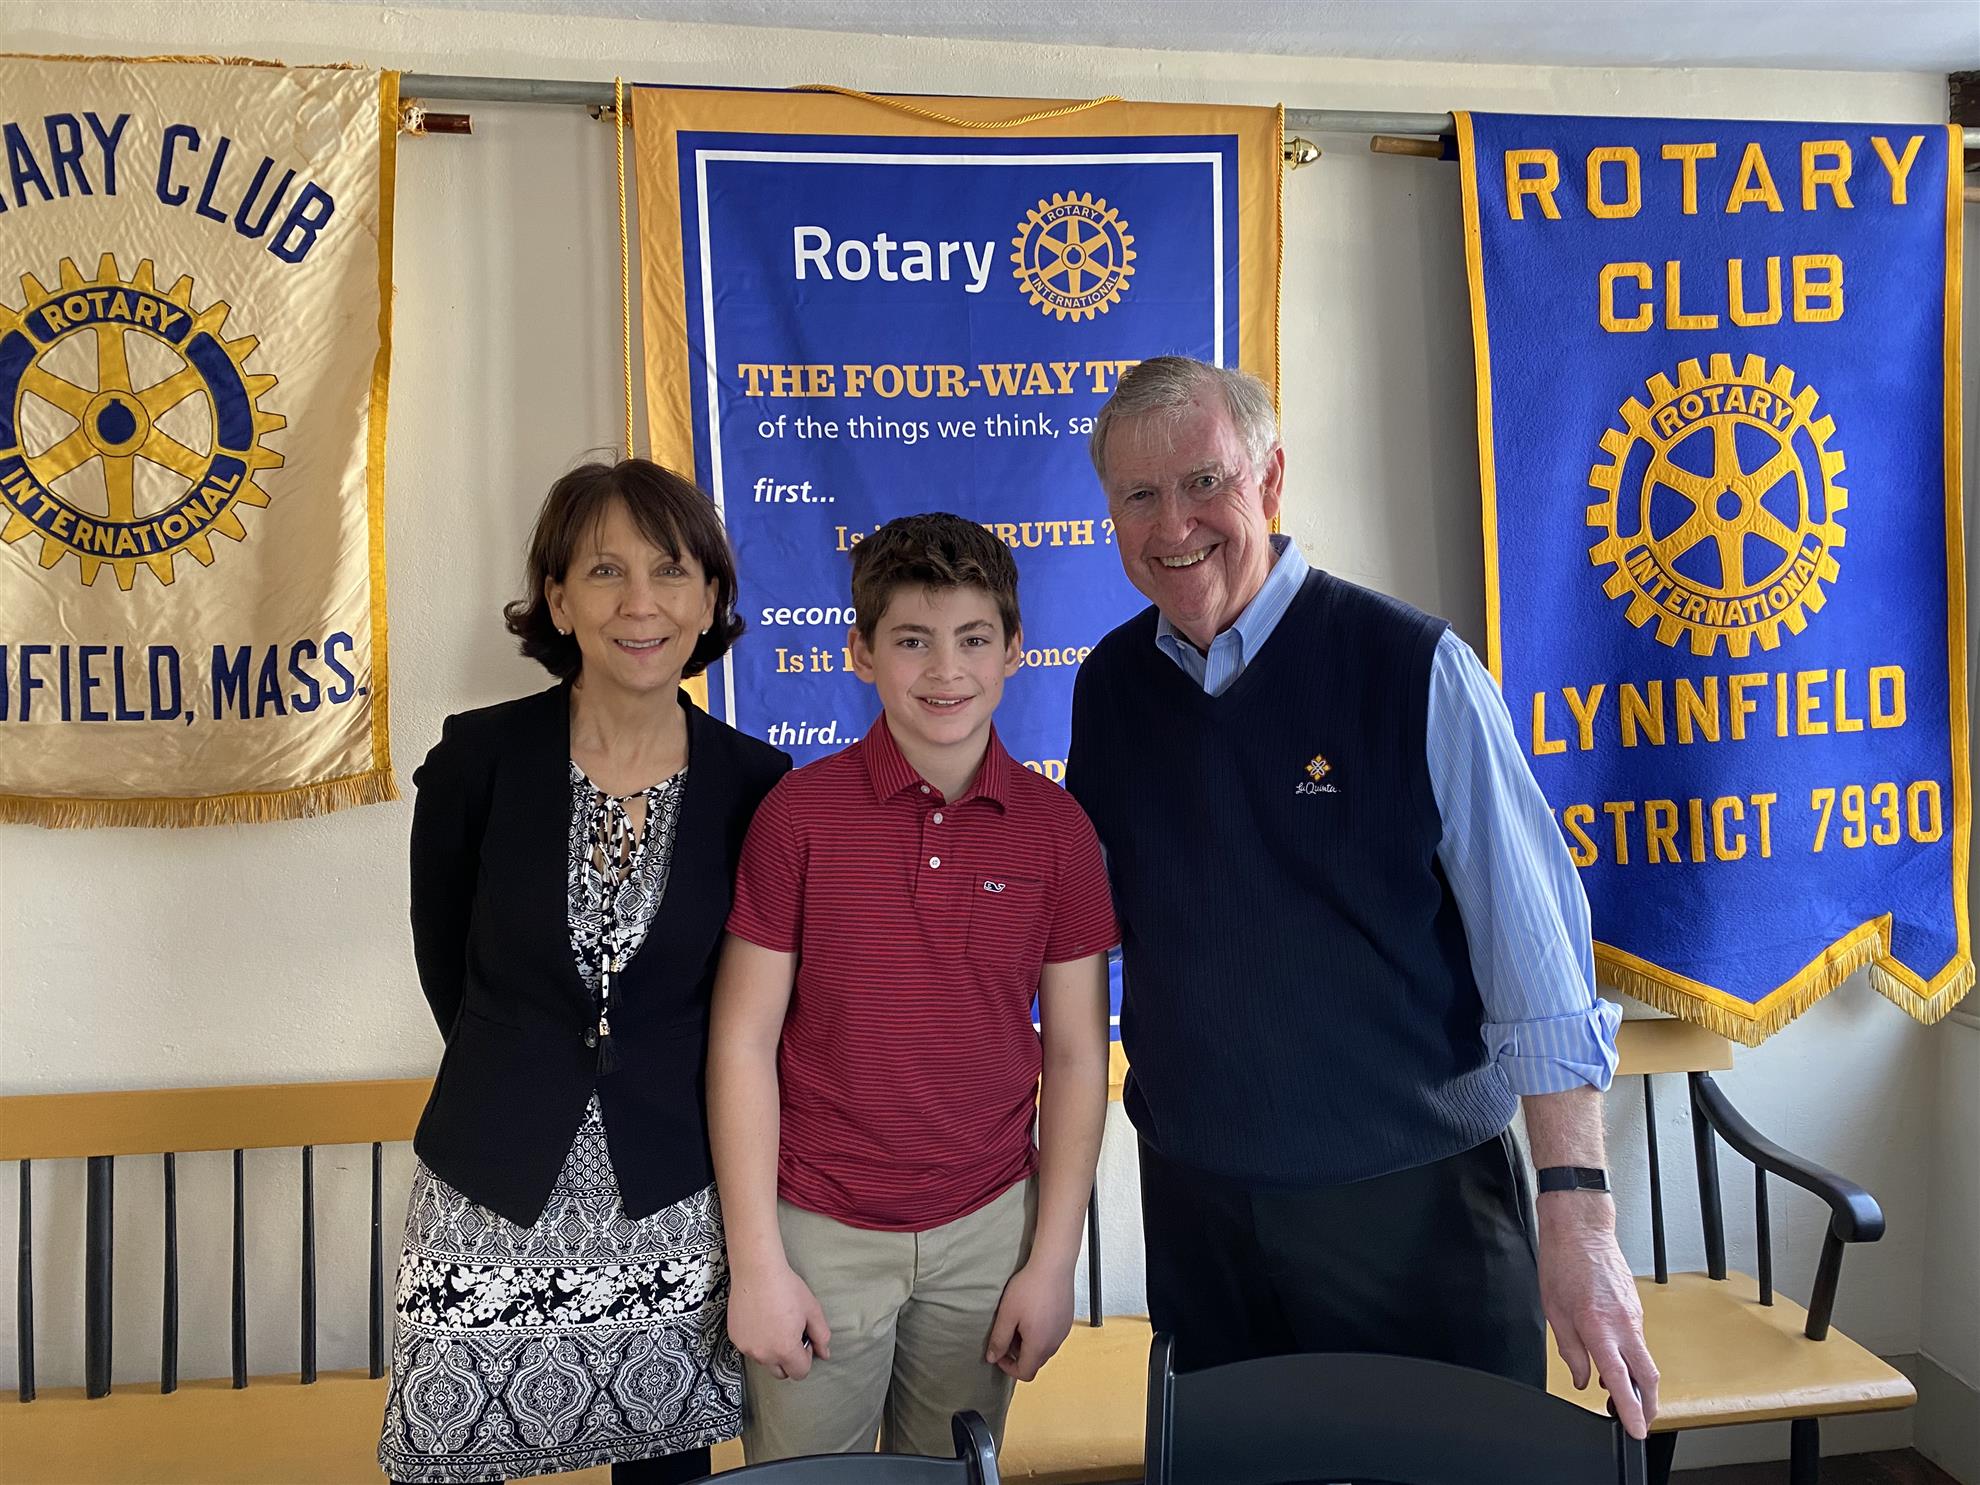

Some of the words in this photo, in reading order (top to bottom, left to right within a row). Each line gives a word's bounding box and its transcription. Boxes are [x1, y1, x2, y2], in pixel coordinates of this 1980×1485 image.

[0, 111, 132, 214] ARY
[156, 123, 335, 264] CLUB
[1505, 135, 1925, 220] ROTARY
[1046, 205, 1099, 222] ROTARY
[794, 225, 996, 293] Rotary
[40, 291, 184, 335] ROTARY
[1031, 275, 1119, 308] INTERNATIONAL
[1599, 254, 1845, 333] CLUB
[737, 363, 837, 398] THE
[842, 362, 1080, 398] FOUR-WAY
[758, 414, 787, 439] of
[794, 415, 839, 439] the
[847, 415, 930, 445] things
[937, 422, 976, 438] we
[984, 412, 1060, 439] think,
[1068, 416, 1098, 435] sa
[1655, 386, 1793, 437] ROTARY
[0, 467, 242, 556] INTERNATIONAL
[753, 477, 835, 503] first...
[982, 519, 1095, 548] RUTH
[1626, 545, 1822, 626] INTERNATIONAL
[211, 631, 368, 721] MASS.
[775, 648, 805, 673] Is
[810, 646, 834, 673] it
[767, 720, 859, 746] third...
[1532, 665, 1906, 755] LYNNFIELD
[1551, 792, 1777, 868] STRICT
[1810, 780, 1942, 854] 7930
